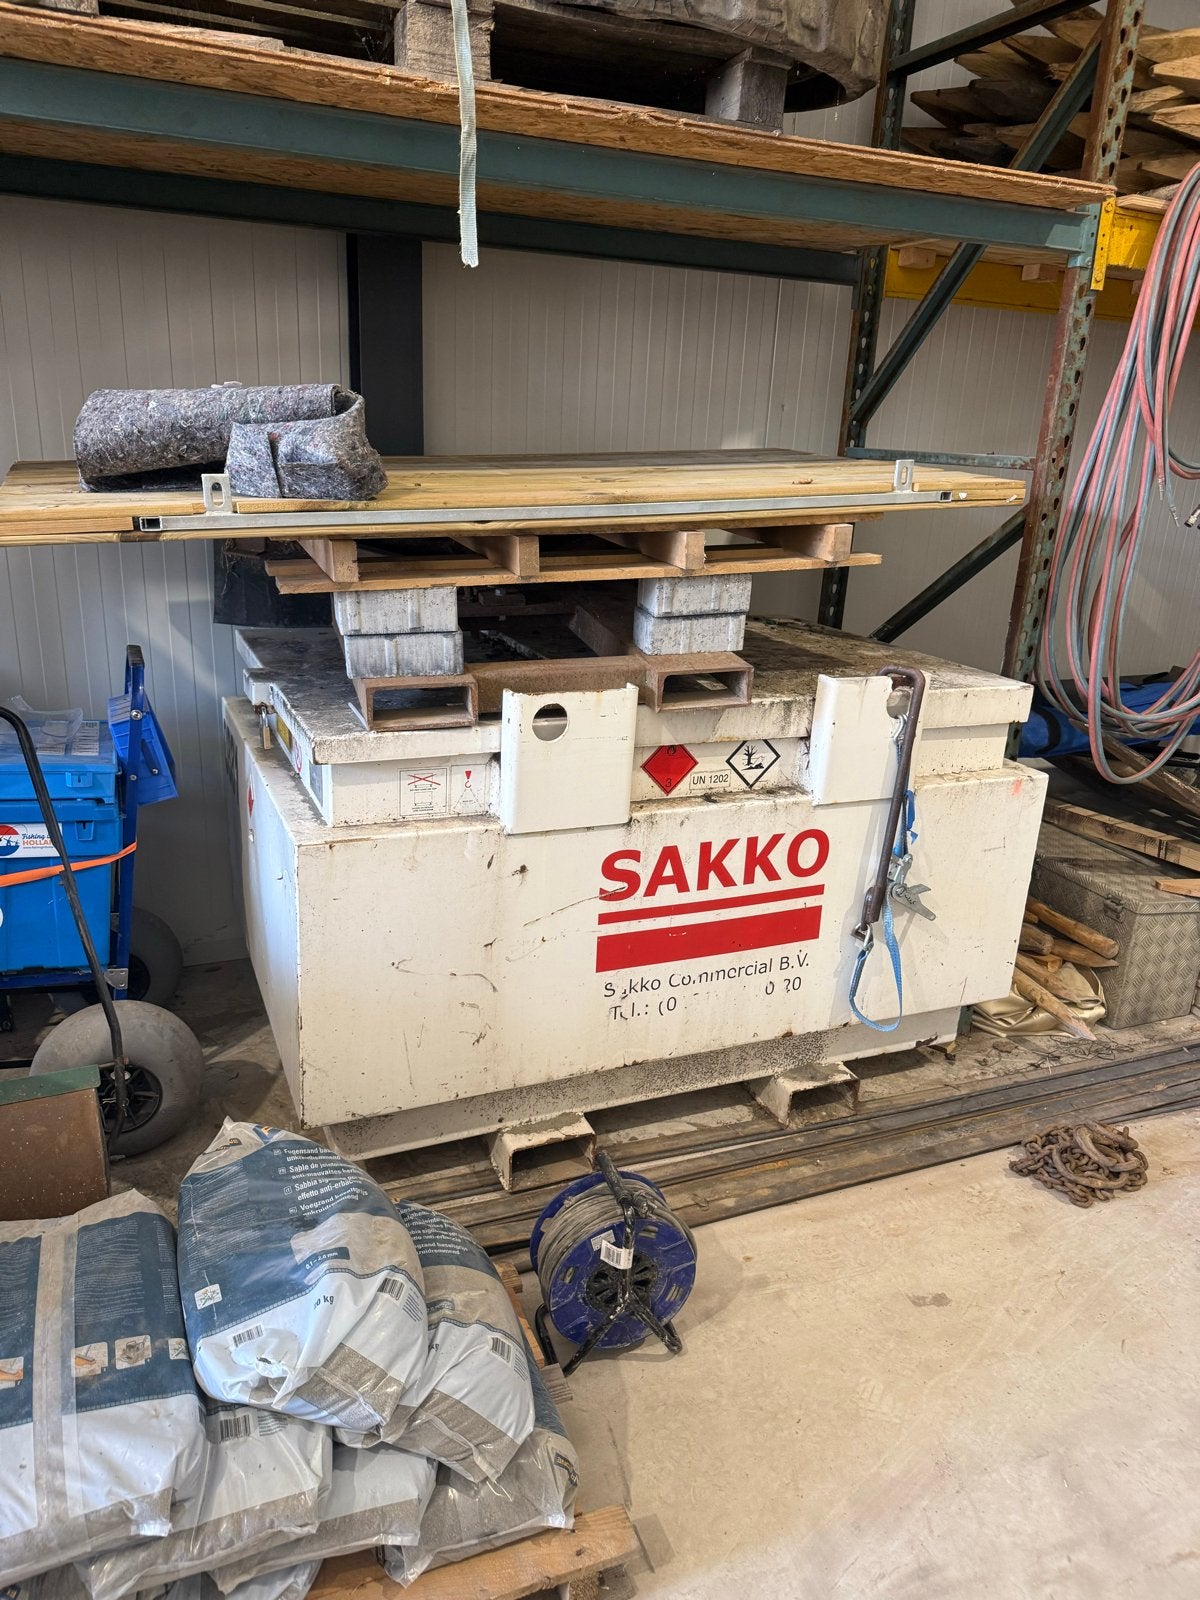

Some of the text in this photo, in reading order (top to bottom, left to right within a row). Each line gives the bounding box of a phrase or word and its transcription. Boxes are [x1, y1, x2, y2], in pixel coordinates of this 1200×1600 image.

[665, 777, 672, 788] 3
[692, 773, 729, 785] UN 1202
[599, 829, 830, 902] SAKKO
[779, 952, 809, 971] B.V.
[289, 1163, 309, 1173] Sable
[294, 1178, 318, 1192] Sabbia
[323, 1294, 335, 1305] kg
